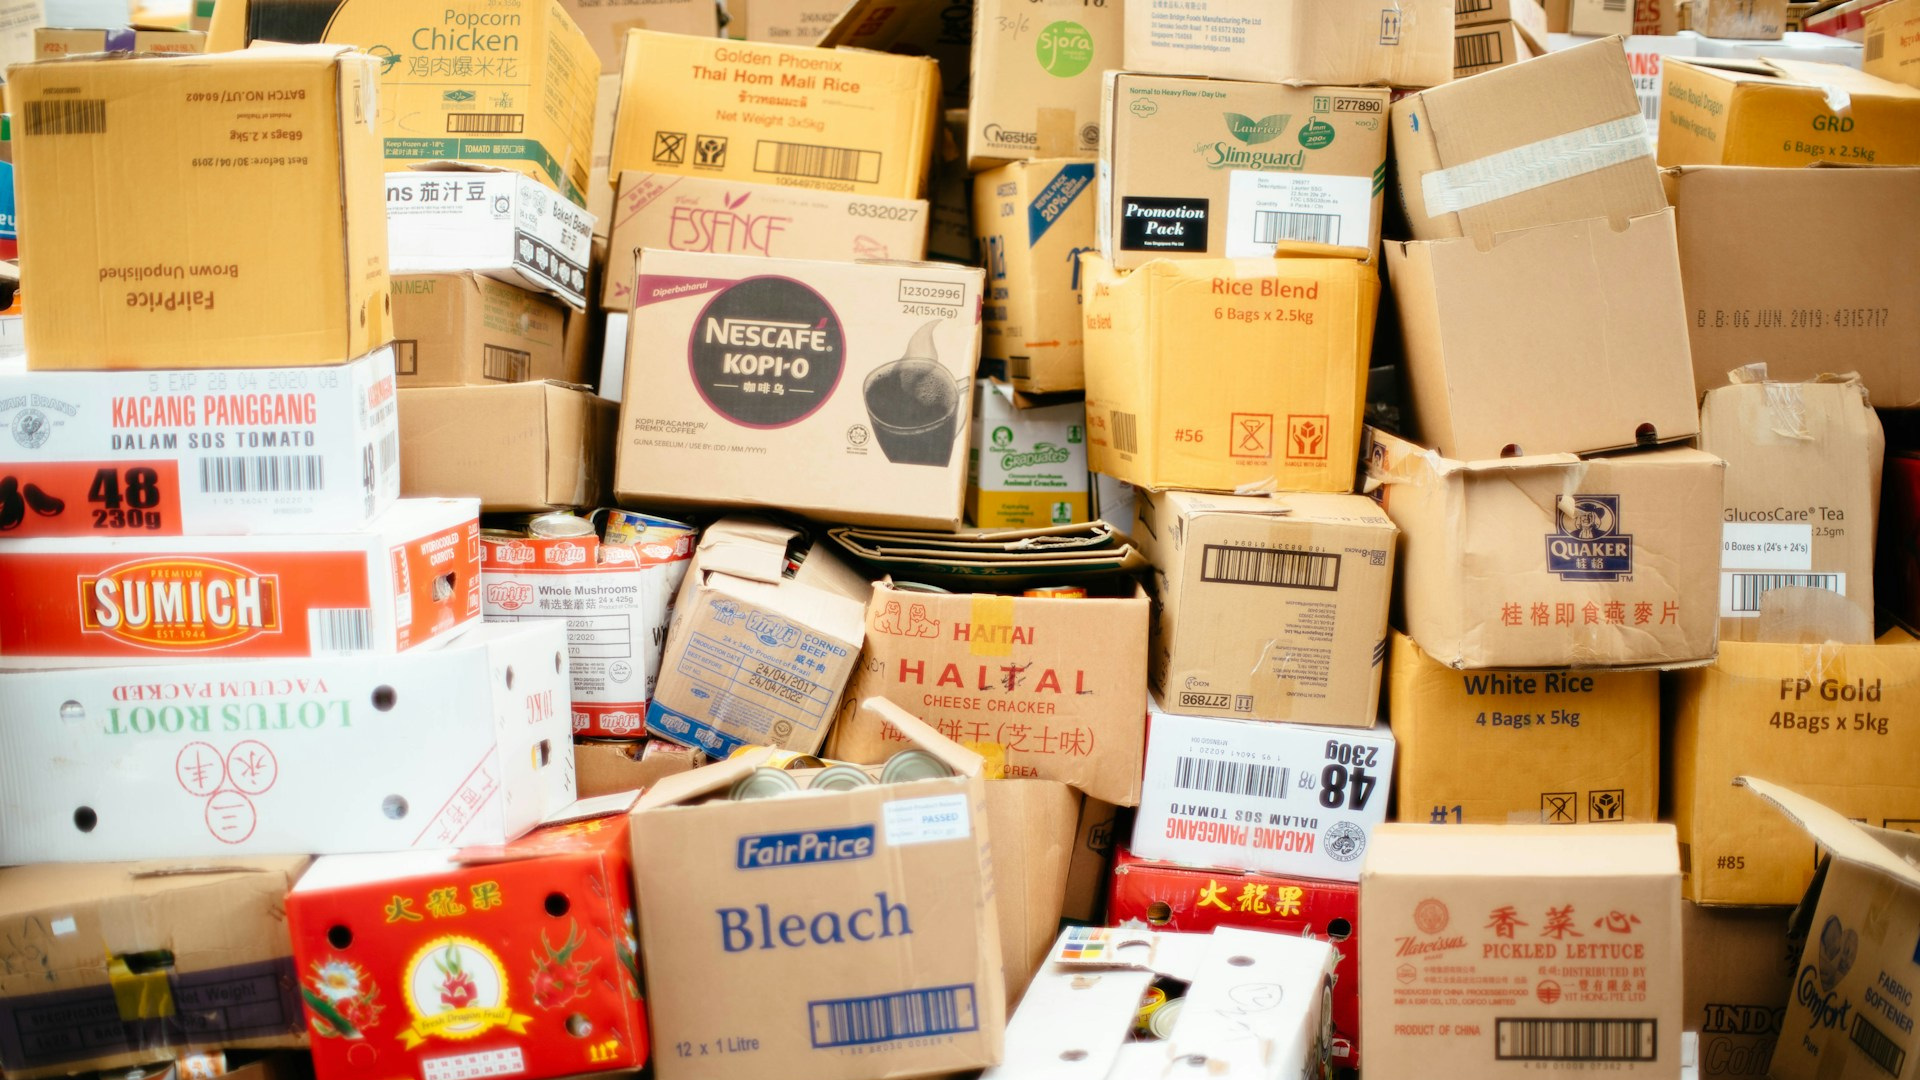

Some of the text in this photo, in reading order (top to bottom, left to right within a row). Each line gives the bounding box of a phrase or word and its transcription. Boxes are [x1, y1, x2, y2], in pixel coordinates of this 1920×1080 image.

[444, 9, 521, 29] Popcorn
[412, 28, 519, 52] Chicken
[1040, 28, 1091, 71] sjora
[407, 56, 518, 78] 鸡肉爆米花
[714, 48, 843, 73] Golden Phoenix
[692, 66, 860, 94] Thai Hom Mali Rice
[268, 90, 305, 100] BATCH
[1129, 87, 1152, 95] Normal
[1161, 88, 1182, 98] Heavy
[1182, 89, 1198, 97] Flow
[1201, 90, 1214, 99] Day
[1336, 99, 1380, 112] 277890
[716, 109, 825, 132] Net Weight 3x5kg
[1233, 121, 1282, 135] Laurier
[1812, 114, 1855, 133] GRD
[230, 129, 302, 142] 6Bags 2.5kg
[386, 141, 402, 149] Keep
[402, 141, 421, 149] frozen
[465, 145, 490, 154] TOMATO
[1206, 141, 1305, 169] Slimguard
[1783, 140, 1876, 161] 6 Bags 2.5kg
[289, 156, 308, 166] Best
[420, 181, 487, 202] 茄汁豆
[848, 202, 918, 222] 6332027
[1040, 193, 1069, 222] 20%
[1125, 203, 1205, 219] Promotion
[1145, 221, 1184, 235] Pack
[100, 263, 238, 282] Brown Unpolished
[405, 280, 436, 294] MEAT
[652, 280, 709, 297] Diperbaharui
[902, 286, 961, 300] 12302996
[1212, 277, 1319, 301] Rice Blend
[126, 291, 214, 312] FairPrice
[902, 304, 958, 319] 24(15x16g)
[1214, 308, 1314, 325] 6 Bags 2.5kg
[723, 353, 810, 379] KOPI-O
[169, 373, 197, 390] EXP
[31, 394, 77, 417] BRAND
[112, 393, 317, 428] KACANG PANGGANG
[112, 430, 314, 450] DALAM SOS TOMATO
[665, 427, 696, 435] COFFEE
[1174, 429, 1204, 443] #56
[654, 440, 684, 448] SEBELUM
[362, 441, 376, 495] 48
[87, 467, 160, 509] 48
[91, 509, 161, 530] 230g
[1818, 507, 1845, 521] Tea
[1816, 527, 1845, 538] 2.5gm
[1550, 540, 1628, 560] QUAKER
[1731, 541, 1756, 551] Boxes
[151, 569, 203, 578] PREMIUM
[538, 584, 638, 596] Whole Mushrooms
[616, 596, 634, 604] 425g
[94, 577, 263, 629] SUMICH
[1501, 600, 1680, 628] 桂格即食燕麥片
[953, 622, 1035, 645] HAITAI
[693, 638, 741, 662] PRODUCTION DATE
[800, 643, 827, 659] BEEF
[805, 633, 848, 658] CORNED
[687, 649, 722, 670] BEST BEFORE
[756, 650, 782, 664] Product
[792, 663, 811, 677] Brazil
[112, 677, 328, 701] VACUUM PACKED
[749, 674, 803, 704] 24/04/2022
[756, 663, 817, 695] 24/04/2017
[1464, 672, 1595, 696] White Rice
[1182, 694, 1228, 706] 277898
[1779, 677, 1882, 703] FP Gold
[923, 694, 1056, 715] CHEESE CRACKER
[104, 700, 353, 735] LOTUS ROOT
[1476, 709, 1580, 730] 4 Bags 5kg
[1769, 711, 1889, 734] 4Bags 5kg
[1324, 739, 1379, 768] 230g
[1319, 764, 1378, 811] 48
[921, 812, 959, 824] PASSED
[1171, 803, 1319, 829] DALAM SOS TOMATO
[1430, 804, 1463, 824] #1
[1166, 818, 1316, 853] KACANG PANGGANG
[743, 833, 871, 866] FairPrice
[1716, 855, 1745, 871] #85
[385, 881, 502, 923] 火龍果
[1197, 879, 1303, 917] 火龍果
[715, 890, 914, 953] Bleach
[1483, 904, 1642, 940] 香菜心
[1482, 943, 1645, 959] PICKLED LETTUCE
[1562, 967, 1629, 977] DISTRIBUTED
[1632, 967, 1646, 977] BY
[1564, 992, 1646, 1001] YIT HONG PTE LTD
[1797, 964, 1853, 1031] Comfort
[1878, 970, 1914, 1007] FABRIC
[447, 1010, 481, 1026] Dragon
[1864, 986, 1915, 1035] SOFTENER
[1394, 1024, 1481, 1036] PRODUCT OF CHINA
[676, 1036, 760, 1057] 12 Litre
[1803, 1034, 1819, 1058] Pure
